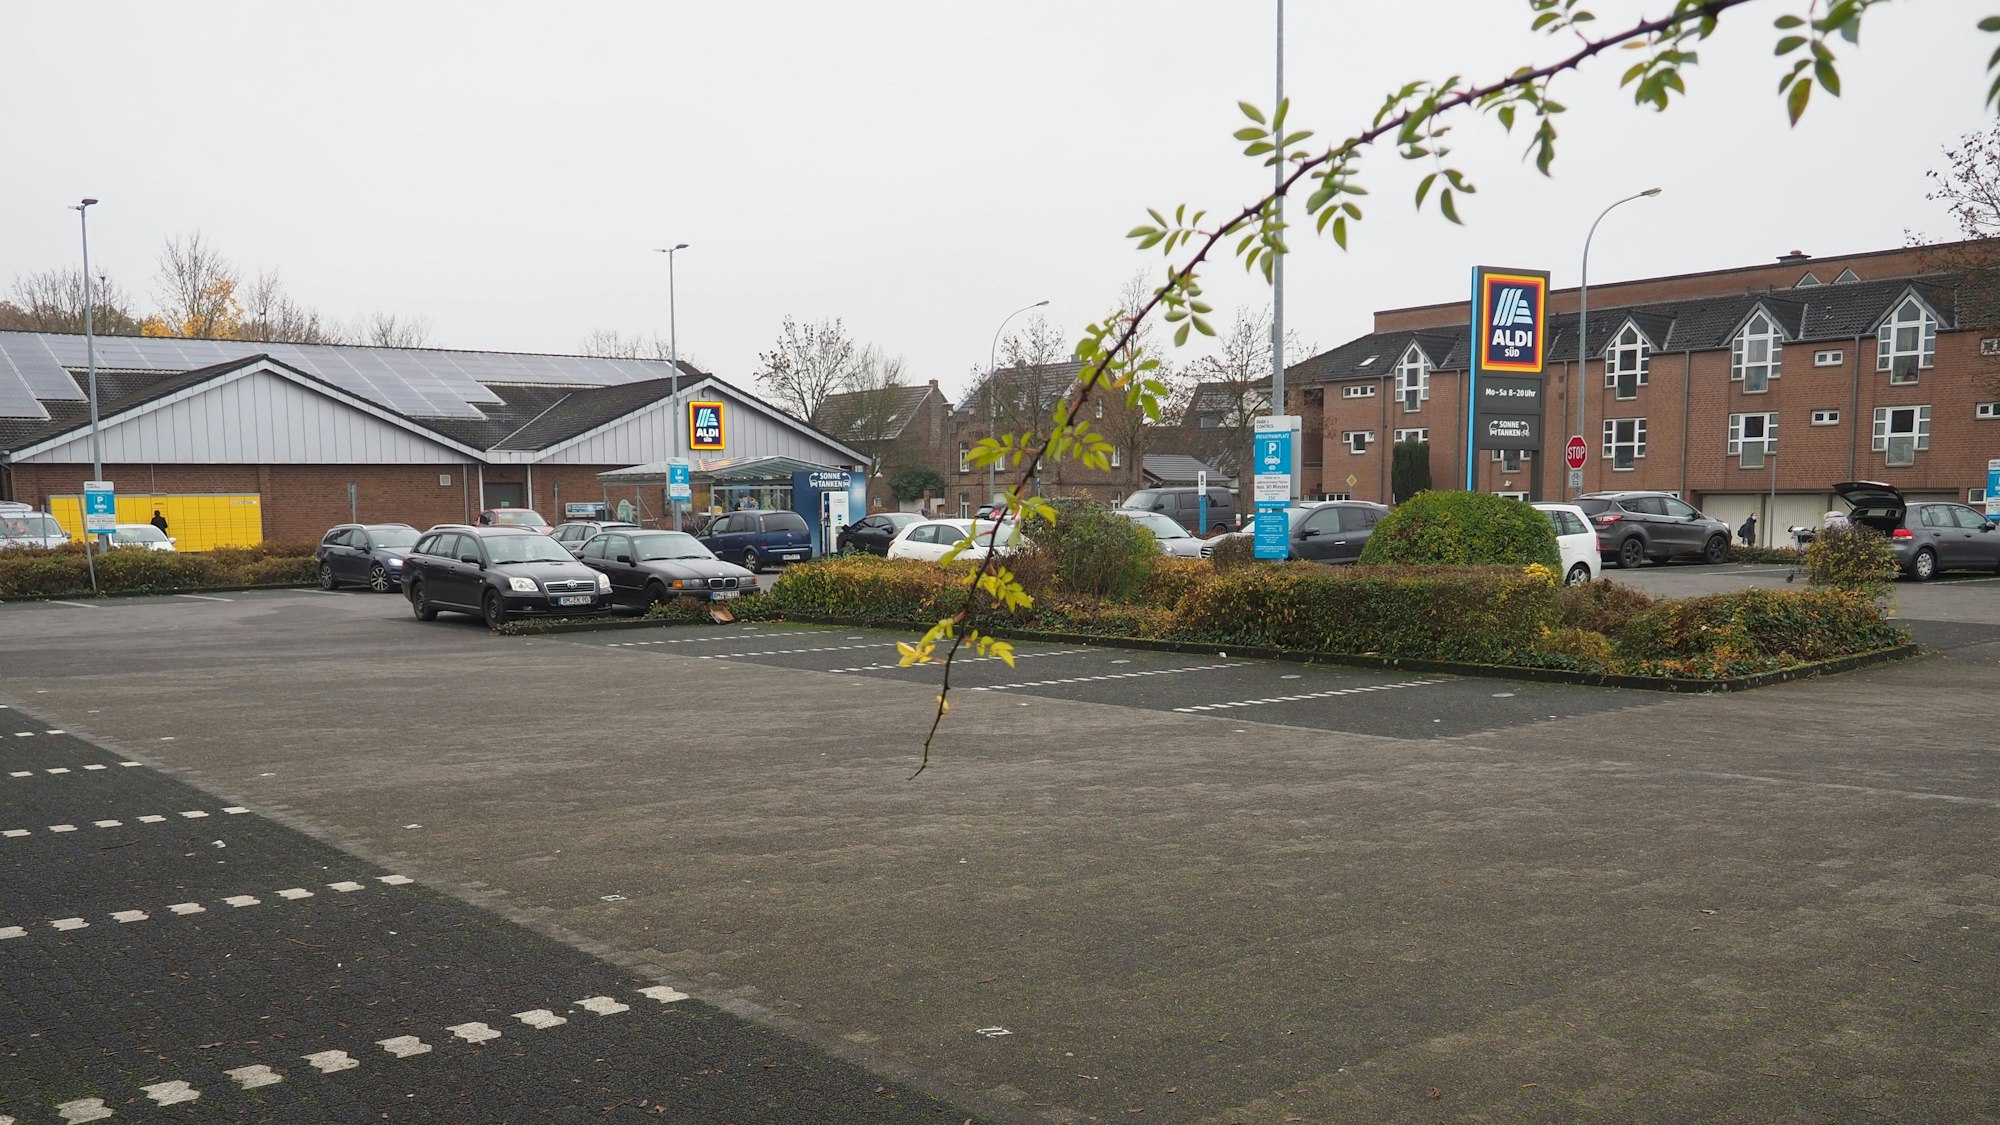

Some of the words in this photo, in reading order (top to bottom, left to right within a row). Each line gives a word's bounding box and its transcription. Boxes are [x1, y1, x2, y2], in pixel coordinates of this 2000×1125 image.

[1492, 329, 1532, 347] ALDI
[1504, 346, 1520, 357] SÜD
[1525, 389, 1536, 397] Uhr
[1499, 420, 1519, 428] SONNE
[696, 428, 719, 437] ALDI
[1497, 428, 1520, 437] TANKEN
[1268, 442, 1276, 455] P
[1568, 446, 1584, 459] STOP
[820, 472, 841, 480] SONNE
[818, 480, 843, 488] TANKEN
